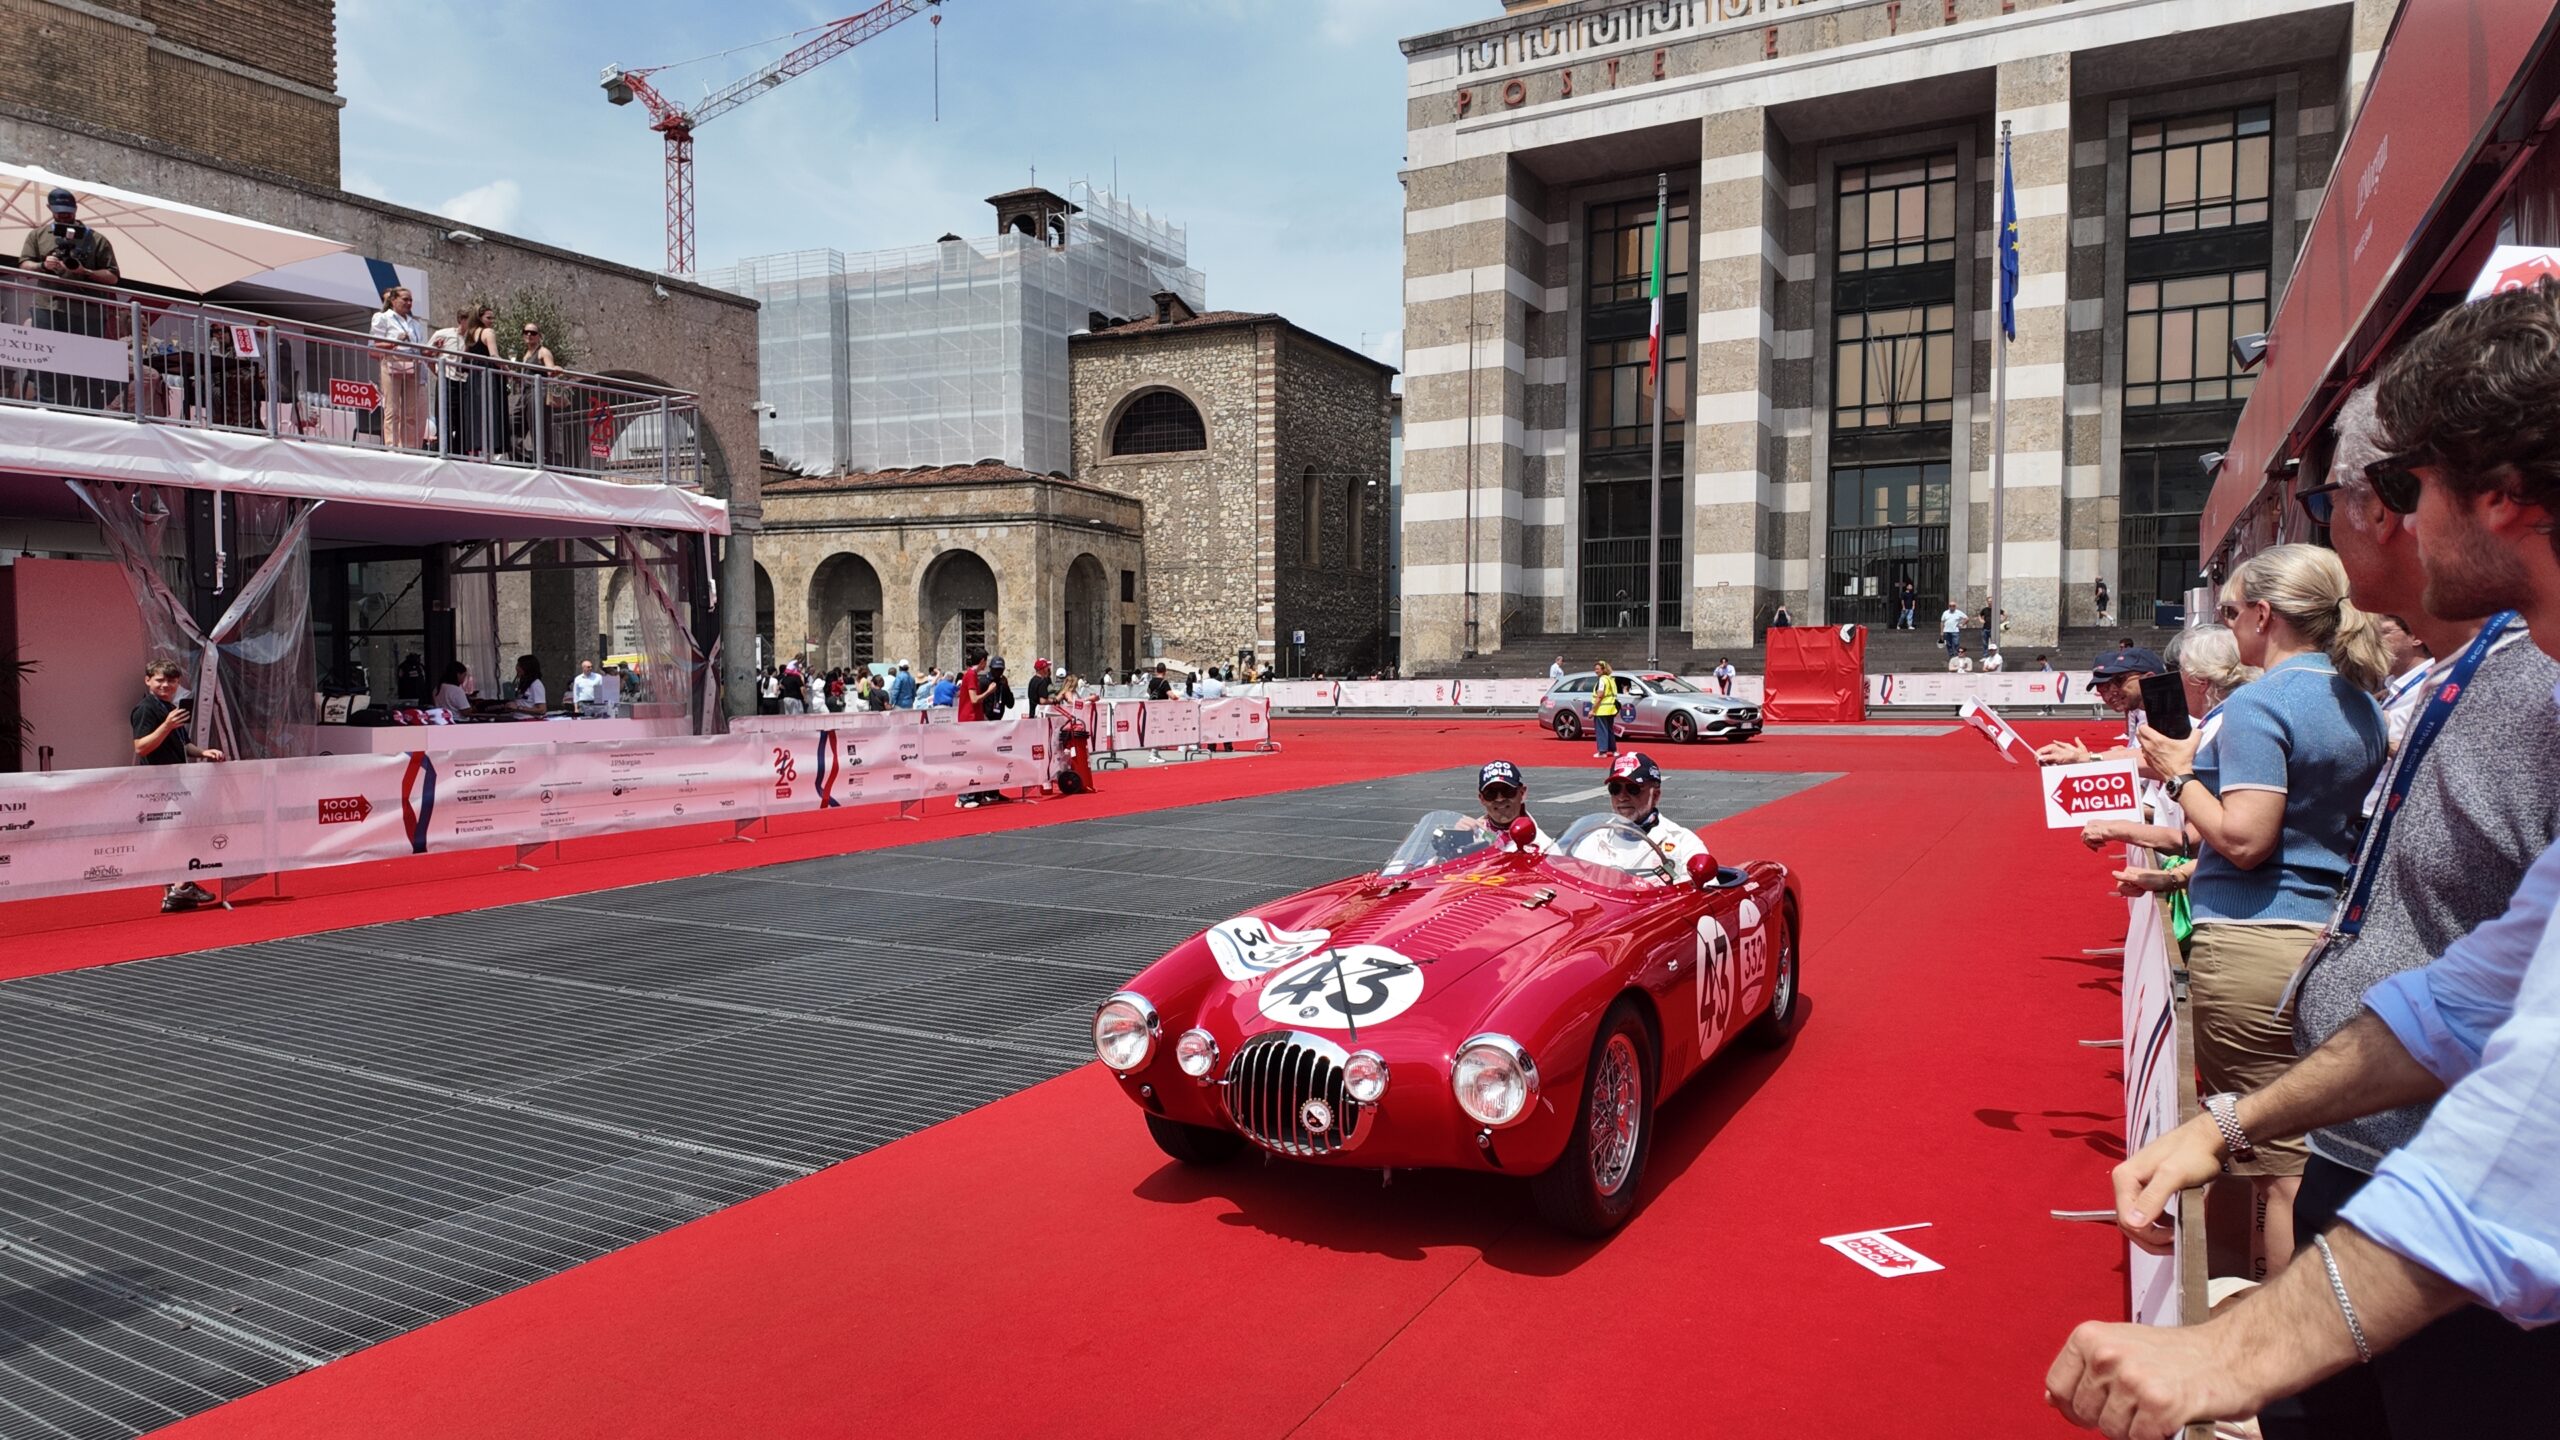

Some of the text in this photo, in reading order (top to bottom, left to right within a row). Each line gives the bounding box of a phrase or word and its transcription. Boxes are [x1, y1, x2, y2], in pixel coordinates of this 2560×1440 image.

[1458, 49, 1666, 114] POSTE
[12, 328, 28, 336] THE
[0, 337, 56, 354] UXURY
[0, 353, 49, 364] OLLECTION
[335, 382, 368, 395] 1000
[333, 393, 372, 408] MIGLIA
[454, 766, 516, 778] CHOPARD
[1483, 767, 1513, 782] MIGLIA
[1484, 761, 1511, 772] 1000
[2071, 775, 2126, 793] 1000
[323, 799, 358, 810] 1000
[2071, 793, 2132, 811] MIGLIA
[322, 810, 361, 823] MIGLIA
[1743, 934, 1763, 980] 332
[1268, 955, 1415, 1016] 43
[1701, 934, 1730, 1038] 43
[1847, 1241, 1889, 1264] 1000
[1860, 1238, 1911, 1262] MIGLIA
